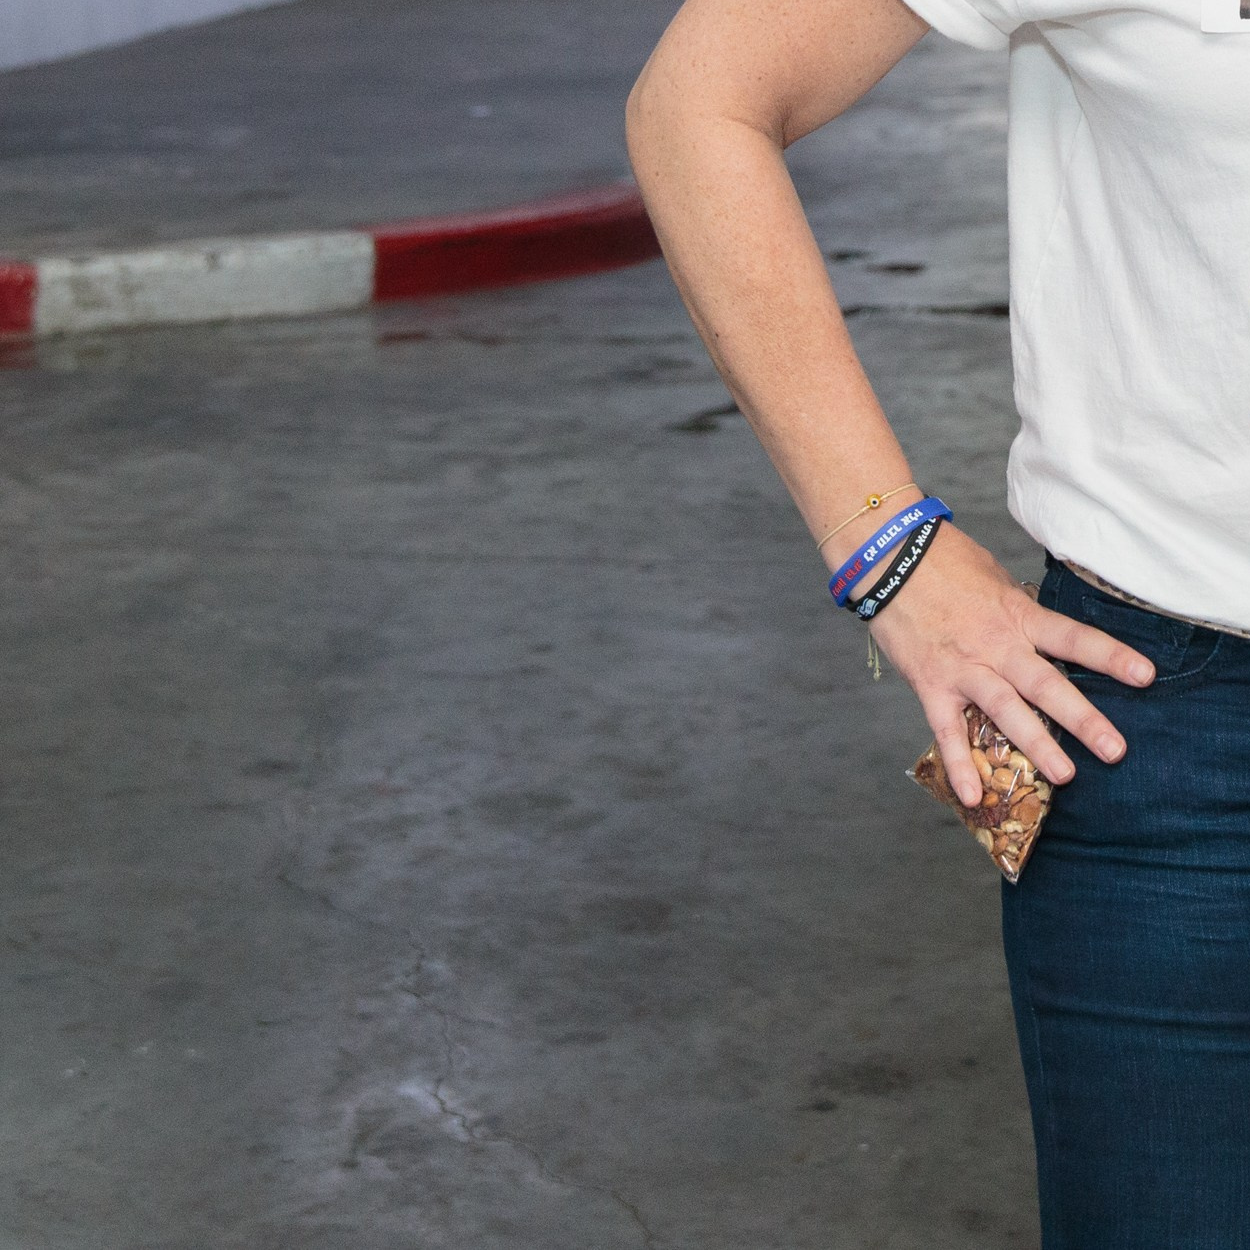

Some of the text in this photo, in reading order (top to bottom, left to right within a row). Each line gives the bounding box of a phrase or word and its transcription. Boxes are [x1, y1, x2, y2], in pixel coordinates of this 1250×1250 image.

[863, 545, 878, 562] לא
[877, 525, 902, 549] מדבר
[876, 575, 901, 600] חיילי
[915, 524, 933, 547] איתי
